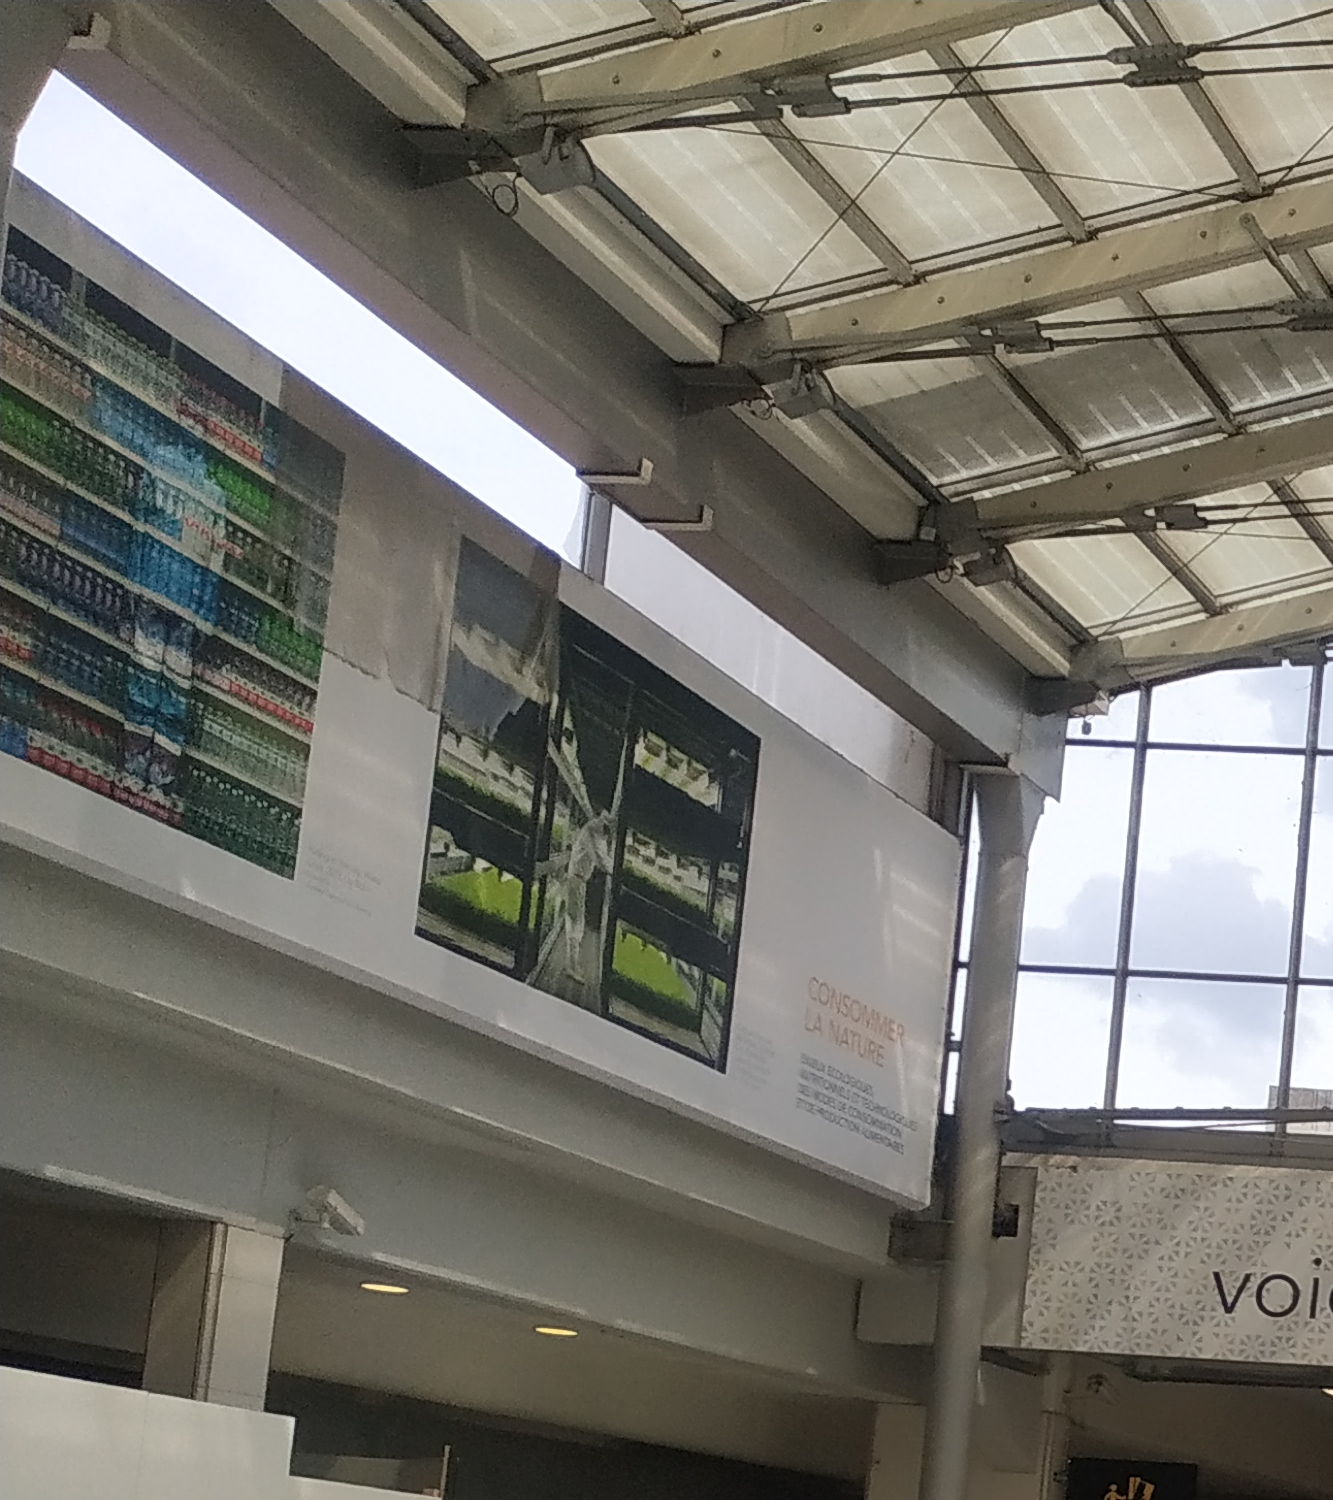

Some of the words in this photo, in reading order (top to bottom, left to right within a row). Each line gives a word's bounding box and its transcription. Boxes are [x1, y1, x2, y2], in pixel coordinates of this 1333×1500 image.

[805, 1008, 822, 1036] LA
[829, 1019, 884, 1067] NATURE
[808, 977, 904, 1044] CONSOMMER
